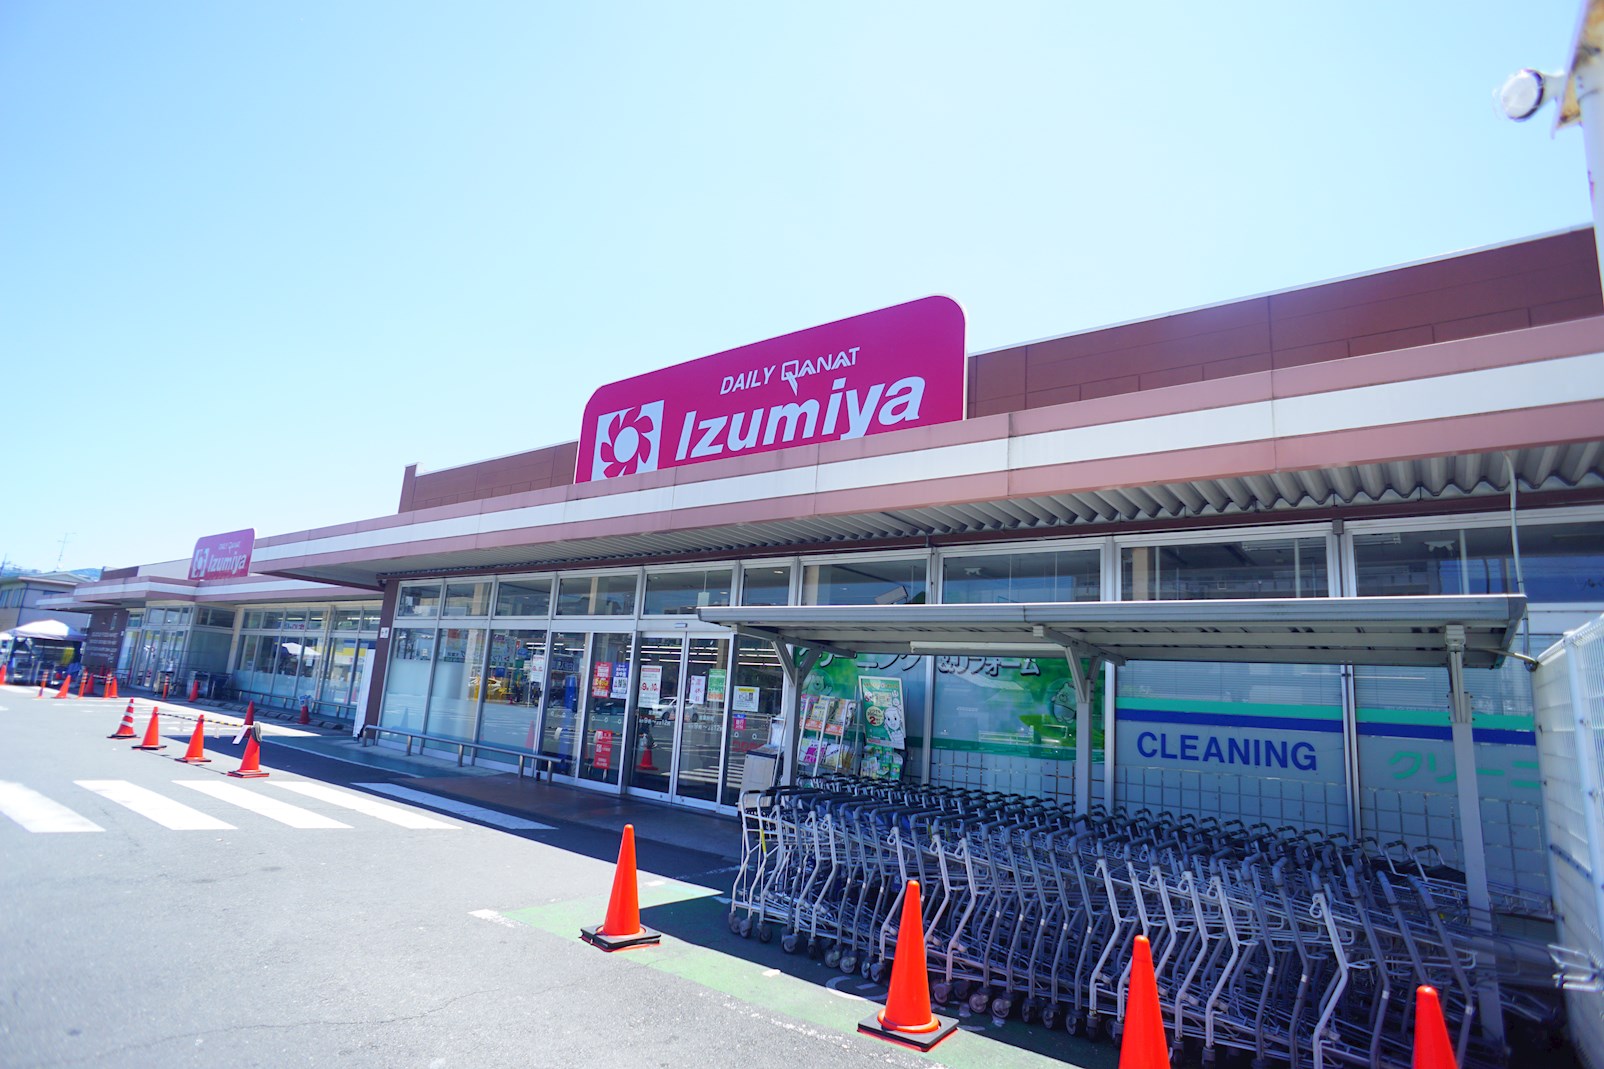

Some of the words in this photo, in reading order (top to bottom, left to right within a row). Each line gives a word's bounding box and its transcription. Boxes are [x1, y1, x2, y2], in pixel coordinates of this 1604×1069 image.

[720, 365, 776, 395] DAILY
[781, 347, 860, 396] QANAT
[675, 375, 925, 461] Izumiya
[208, 551, 247, 575] Izumiya
[1137, 731, 1317, 771] CLEANING
